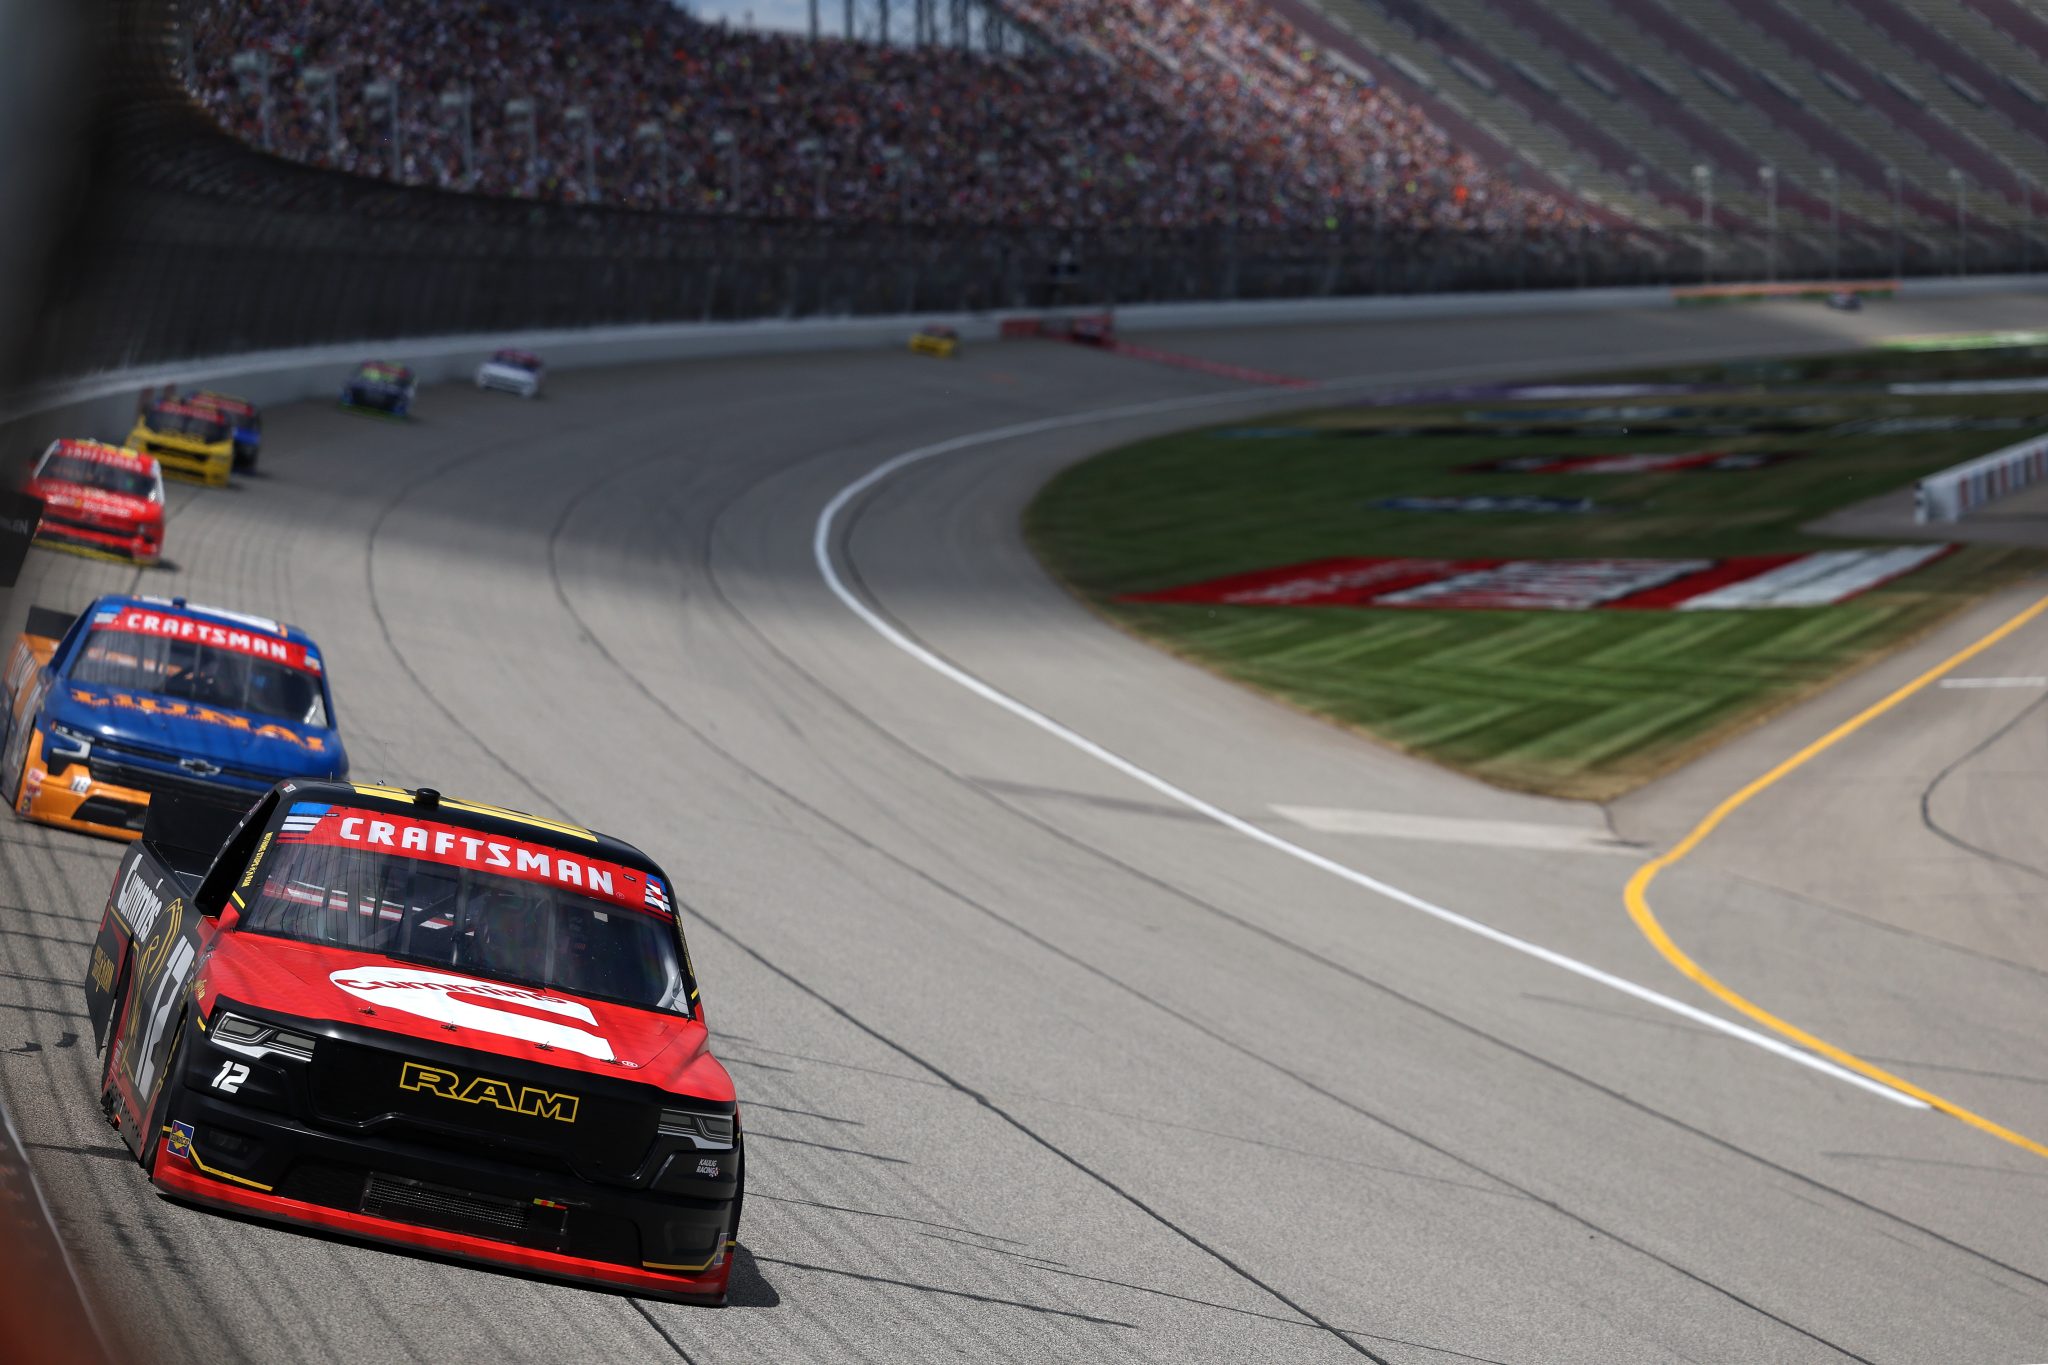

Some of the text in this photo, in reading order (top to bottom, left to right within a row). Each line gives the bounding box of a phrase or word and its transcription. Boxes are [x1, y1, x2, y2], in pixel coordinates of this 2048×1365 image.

[126, 612, 287, 660] CRAFTSMAN
[340, 817, 614, 896] CRAFTSMAN
[333, 978, 568, 1004] Cummins
[211, 1060, 250, 1094] 12
[399, 1061, 580, 1123] RAM
[695, 1165, 716, 1175] RACING
[698, 1158, 717, 1167] KAULIG
